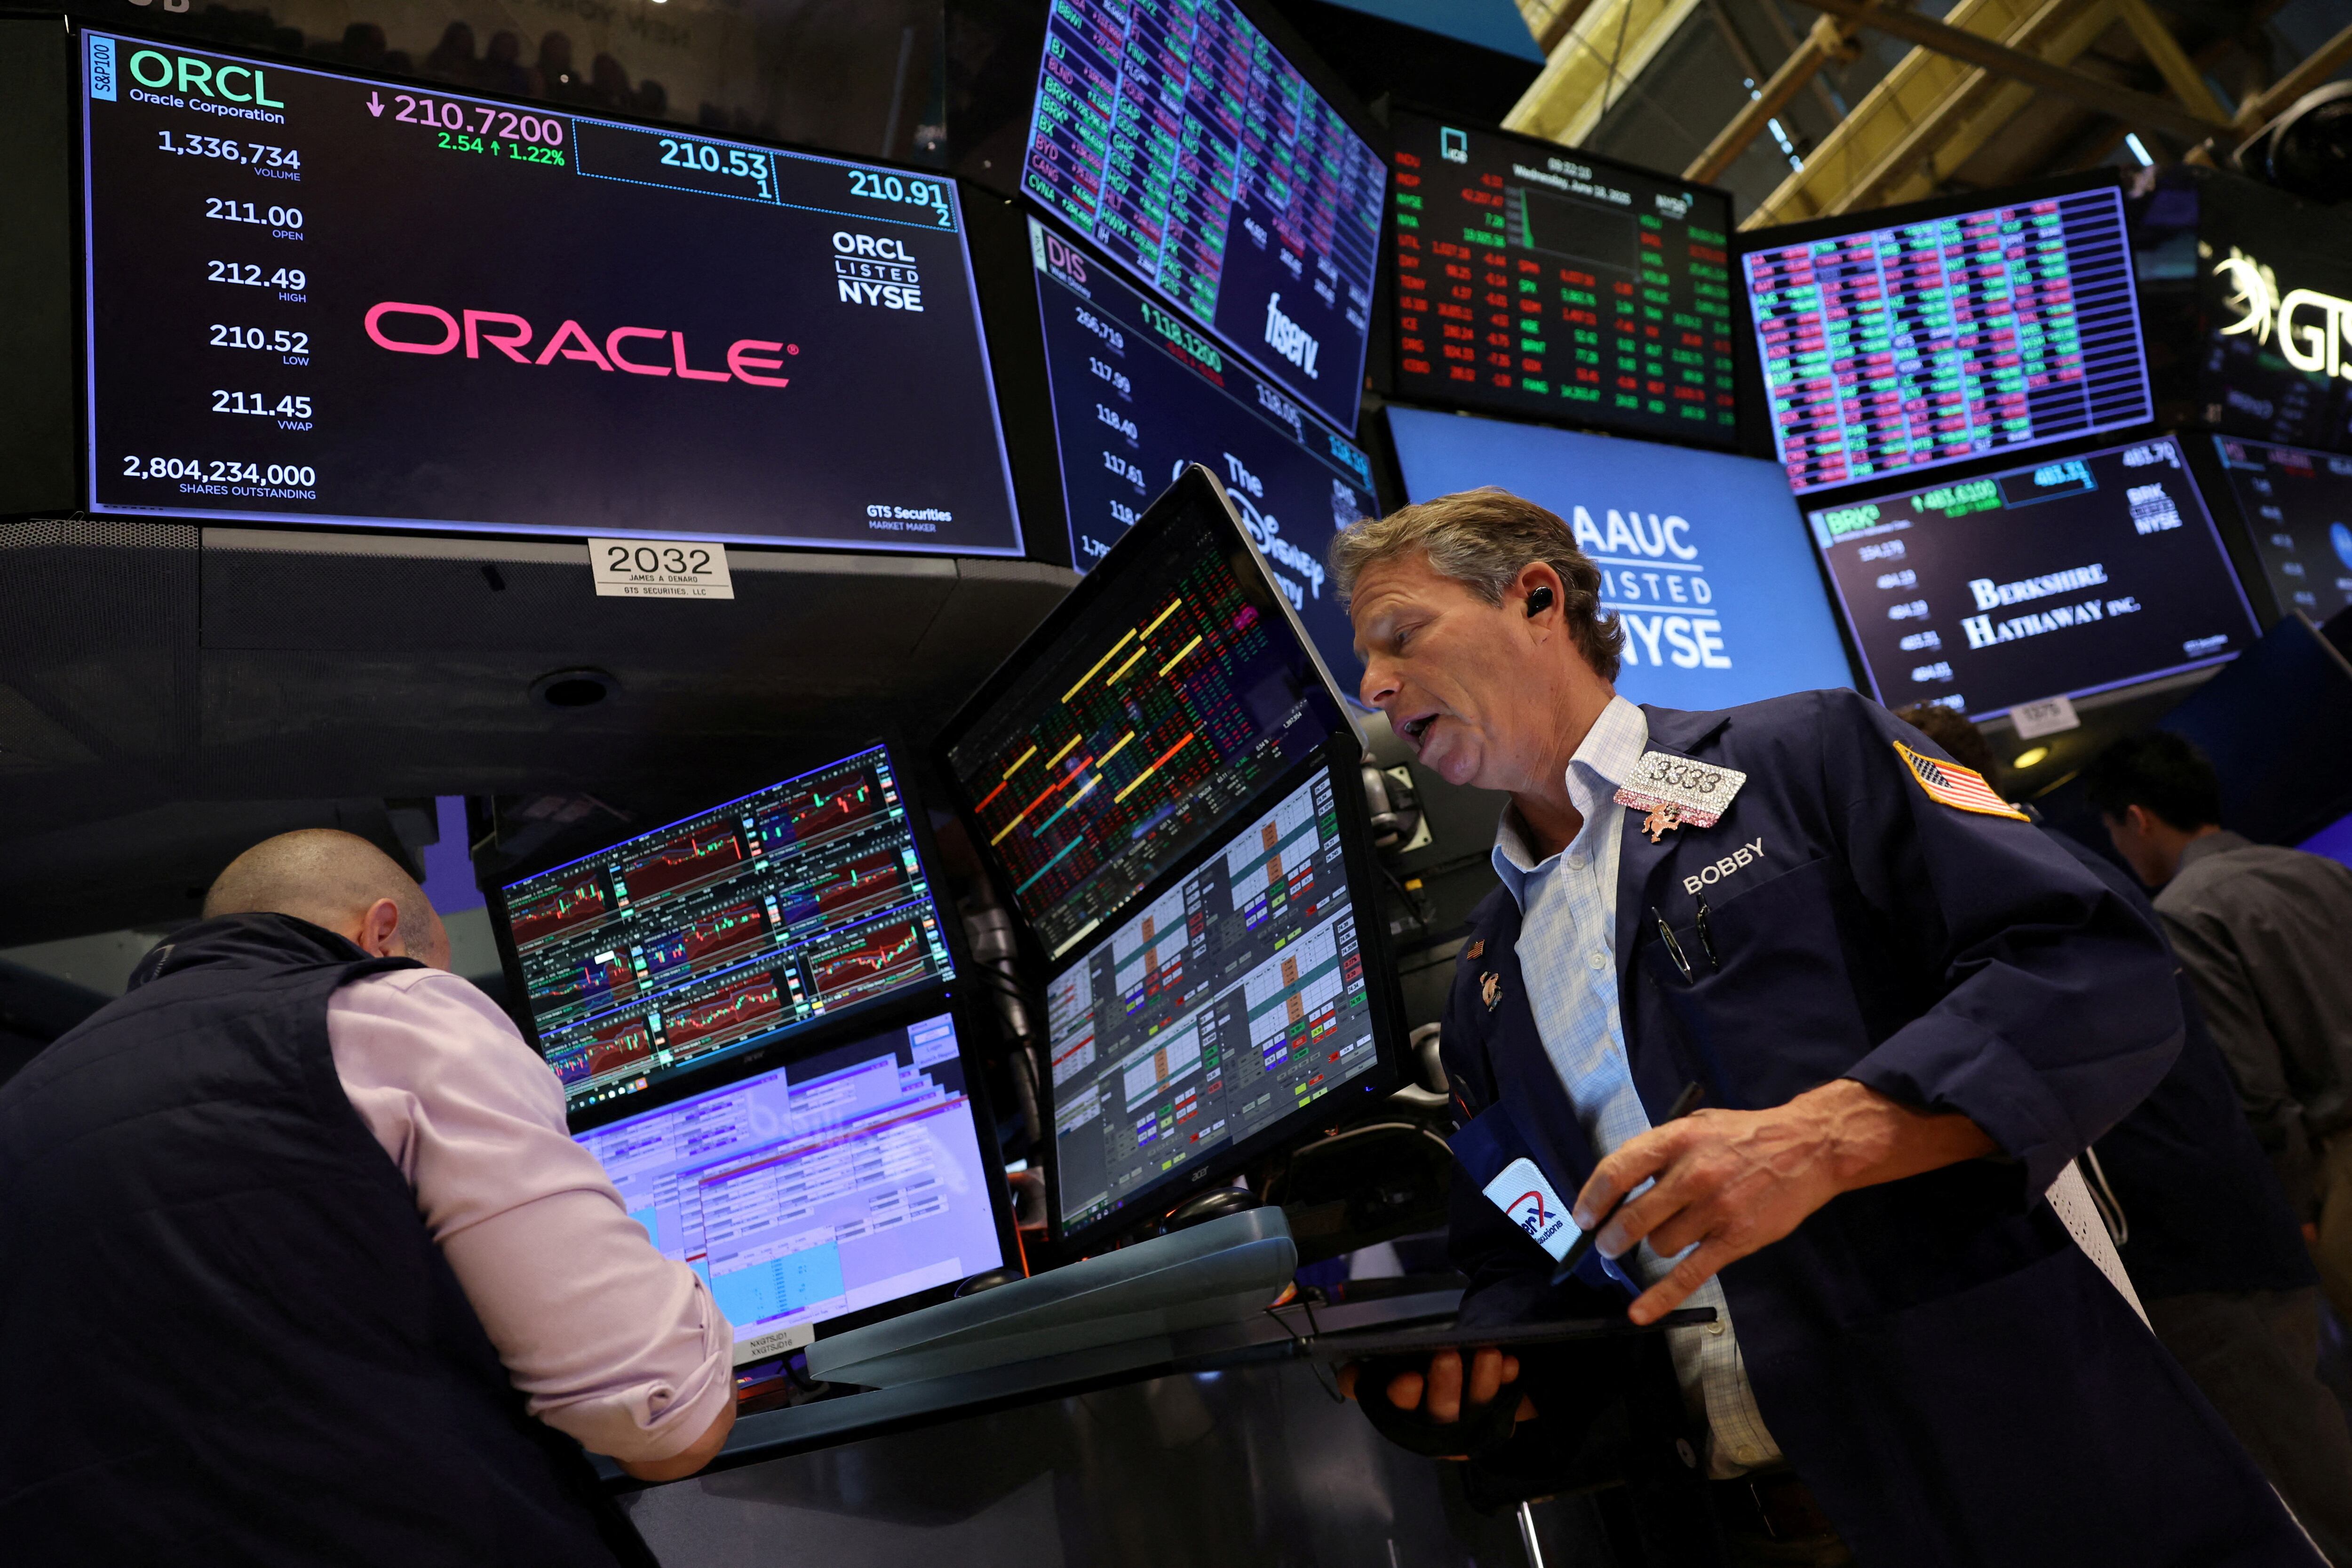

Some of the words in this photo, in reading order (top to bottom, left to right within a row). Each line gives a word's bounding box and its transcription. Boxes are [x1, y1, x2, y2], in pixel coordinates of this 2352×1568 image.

[1051, 37, 1065, 60] BJ
[95, 44, 111, 92] S&P100
[130, 50, 284, 108] ORCL
[130, 88, 184, 109] Oracle
[189, 98, 285, 124] Corporation
[394, 95, 563, 146] 210.7200
[1039, 115, 1054, 137] BX
[159, 130, 301, 170] 1,336,734
[438, 132, 484, 154] 2.54
[509, 143, 565, 166] 1.22%
[660, 139, 768, 180] 210.53
[1036, 135, 1058, 161] BYD
[254, 167, 301, 182] VOLUME
[1033, 154, 1058, 182] CANG
[757, 180, 772, 199] 1
[848, 170, 948, 209] 210.91
[1029, 174, 1055, 201] CVNA
[205, 197, 303, 229] 211.00
[937, 209, 951, 227] 2
[272, 230, 303, 241] OPEN
[832, 231, 915, 263] ORCL
[835, 259, 919, 284] LISTED
[1047, 235, 1087, 283] DIS
[207, 260, 306, 290] 212.49
[278, 291, 306, 303] HIGH
[837, 279, 923, 312] NYSE
[209, 324, 309, 354] 210.52
[282, 356, 310, 367] LOW
[212, 390, 312, 418] 211.45
[278, 420, 313, 431] VWAP
[123, 456, 316, 487] 2,804,234,000
[1224, 452, 1263, 498] The
[179, 483, 228, 495] SHARES
[231, 486, 316, 500] OUTSTANDING
[866, 505, 891, 519] GTS
[894, 506, 952, 522] Securities
[869, 520, 903, 531] MARKET
[906, 523, 937, 533] MAKER
[2135, 510, 2182, 535] NYSE
[1573, 505, 1698, 560] AAUC
[608, 547, 712, 574] 2032
[1598, 569, 1712, 605] ISTED
[1634, 782, 1661, 794] ROBERT
[1650, 761, 1722, 793] 3333
[1683, 837, 1764, 895] BOBBY
[1192, 1166, 1208, 1182] acer
